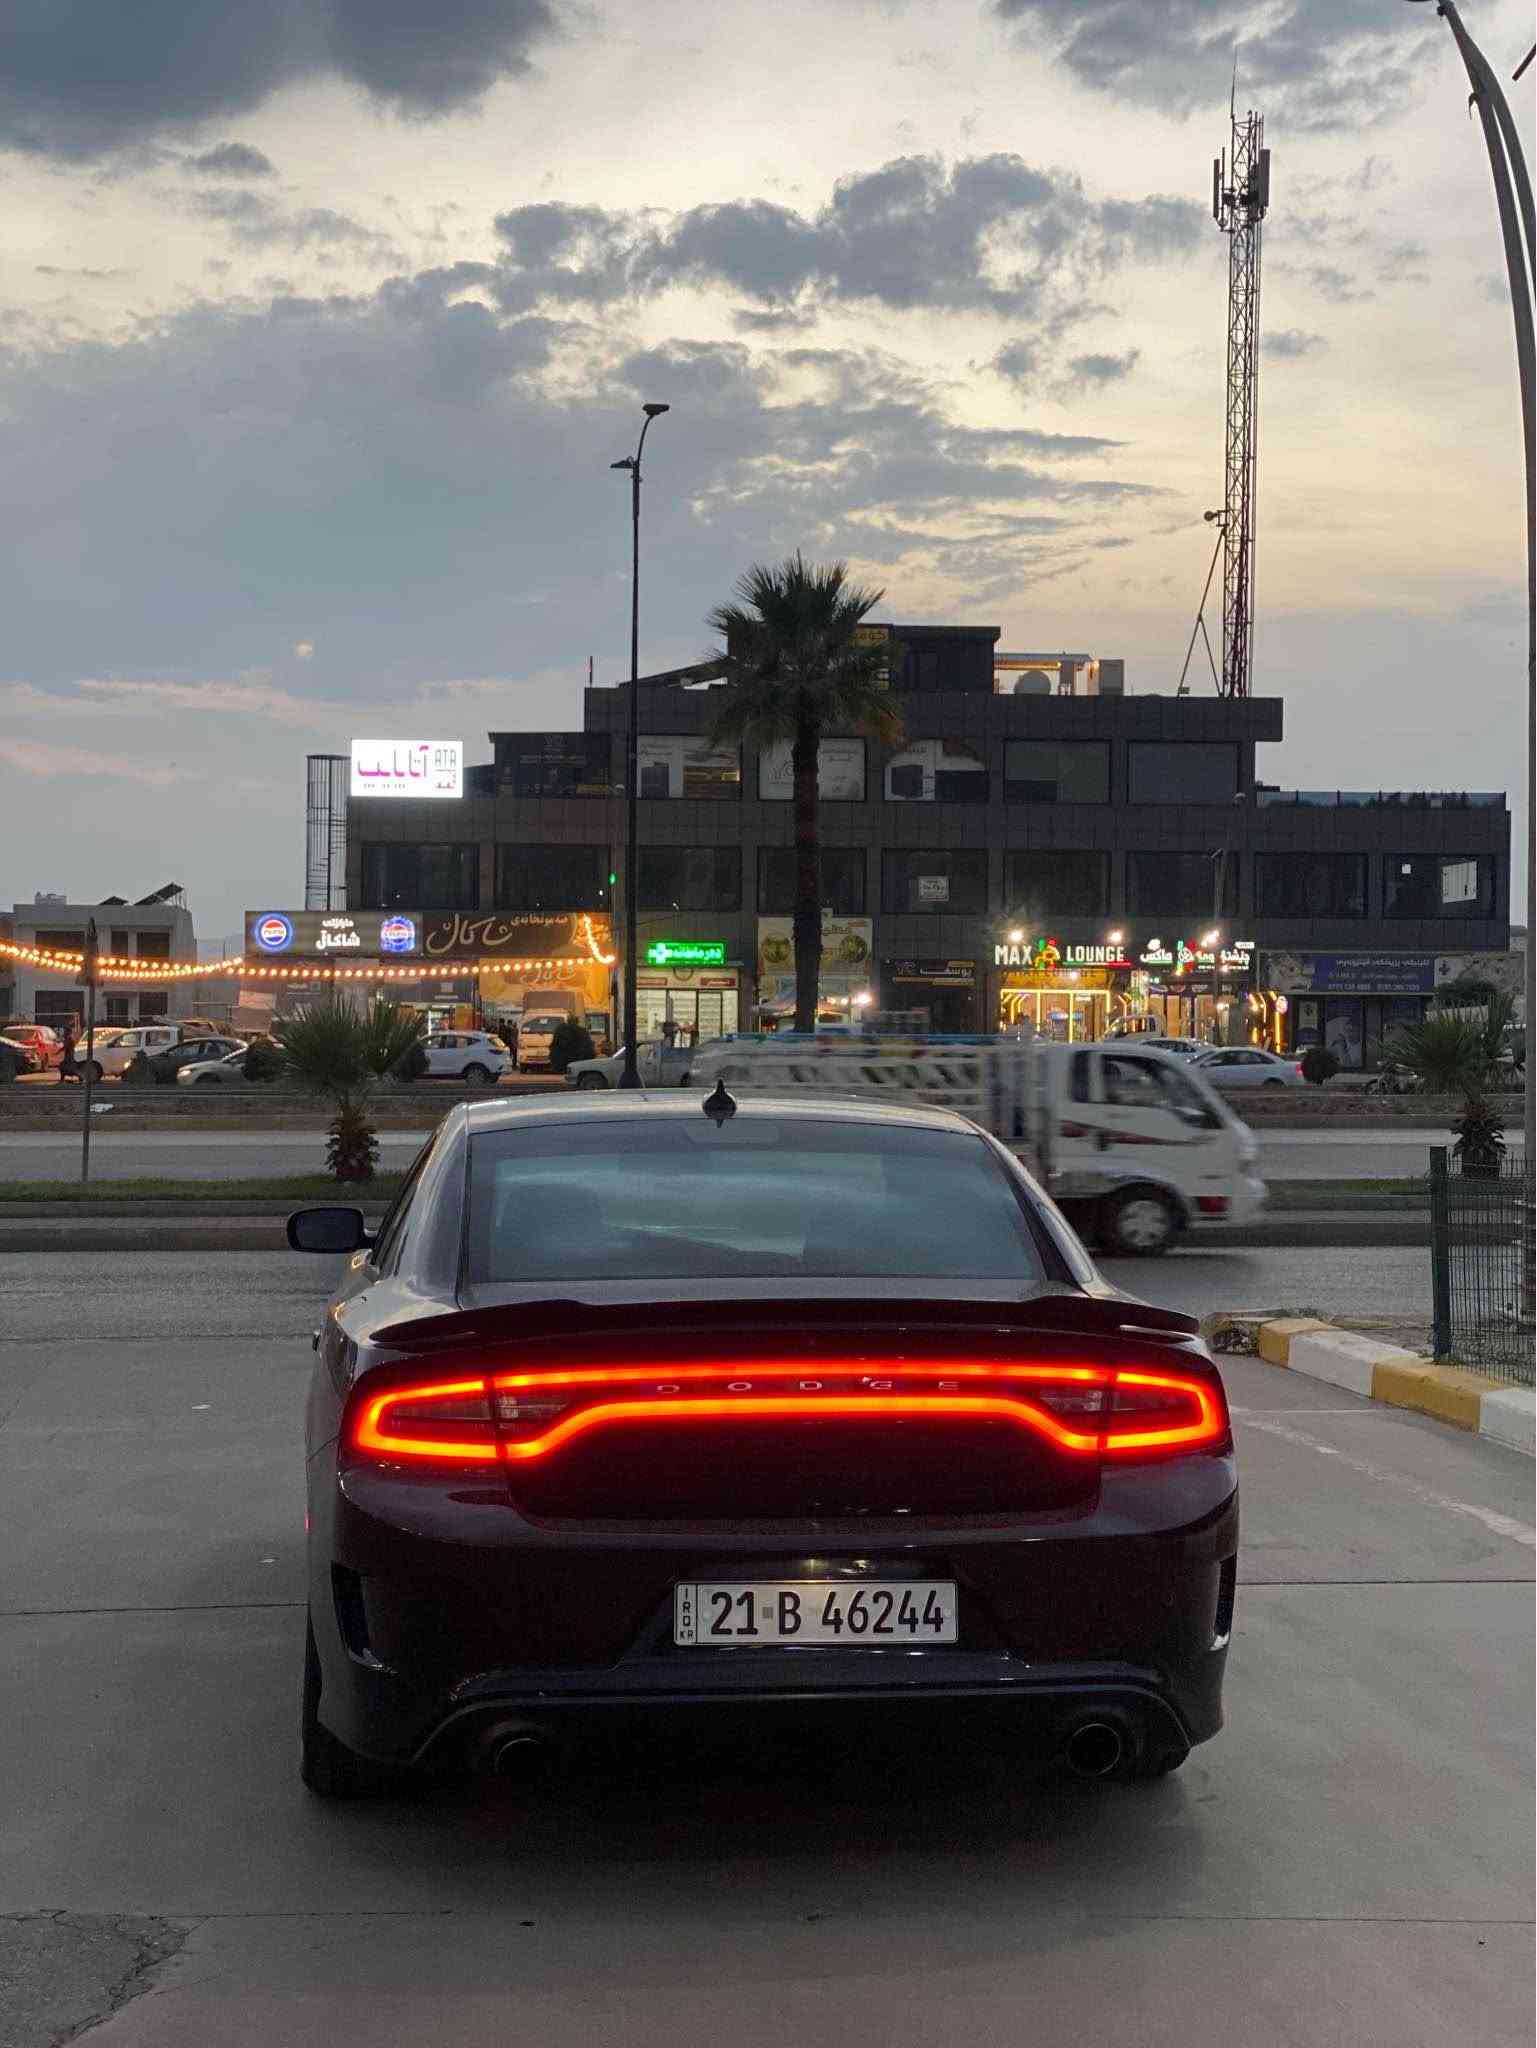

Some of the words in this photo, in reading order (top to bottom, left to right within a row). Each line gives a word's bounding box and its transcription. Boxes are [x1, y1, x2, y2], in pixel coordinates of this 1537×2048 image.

[434, 749, 456, 768] ATA
[994, 944, 1033, 965] MAX
[1066, 945, 1125, 962] LOUNGE
[656, 1380, 960, 1394] DODGE
[711, 1591, 758, 1635] 21
[778, 1591, 801, 1635] B
[822, 1590, 944, 1635] 46244
